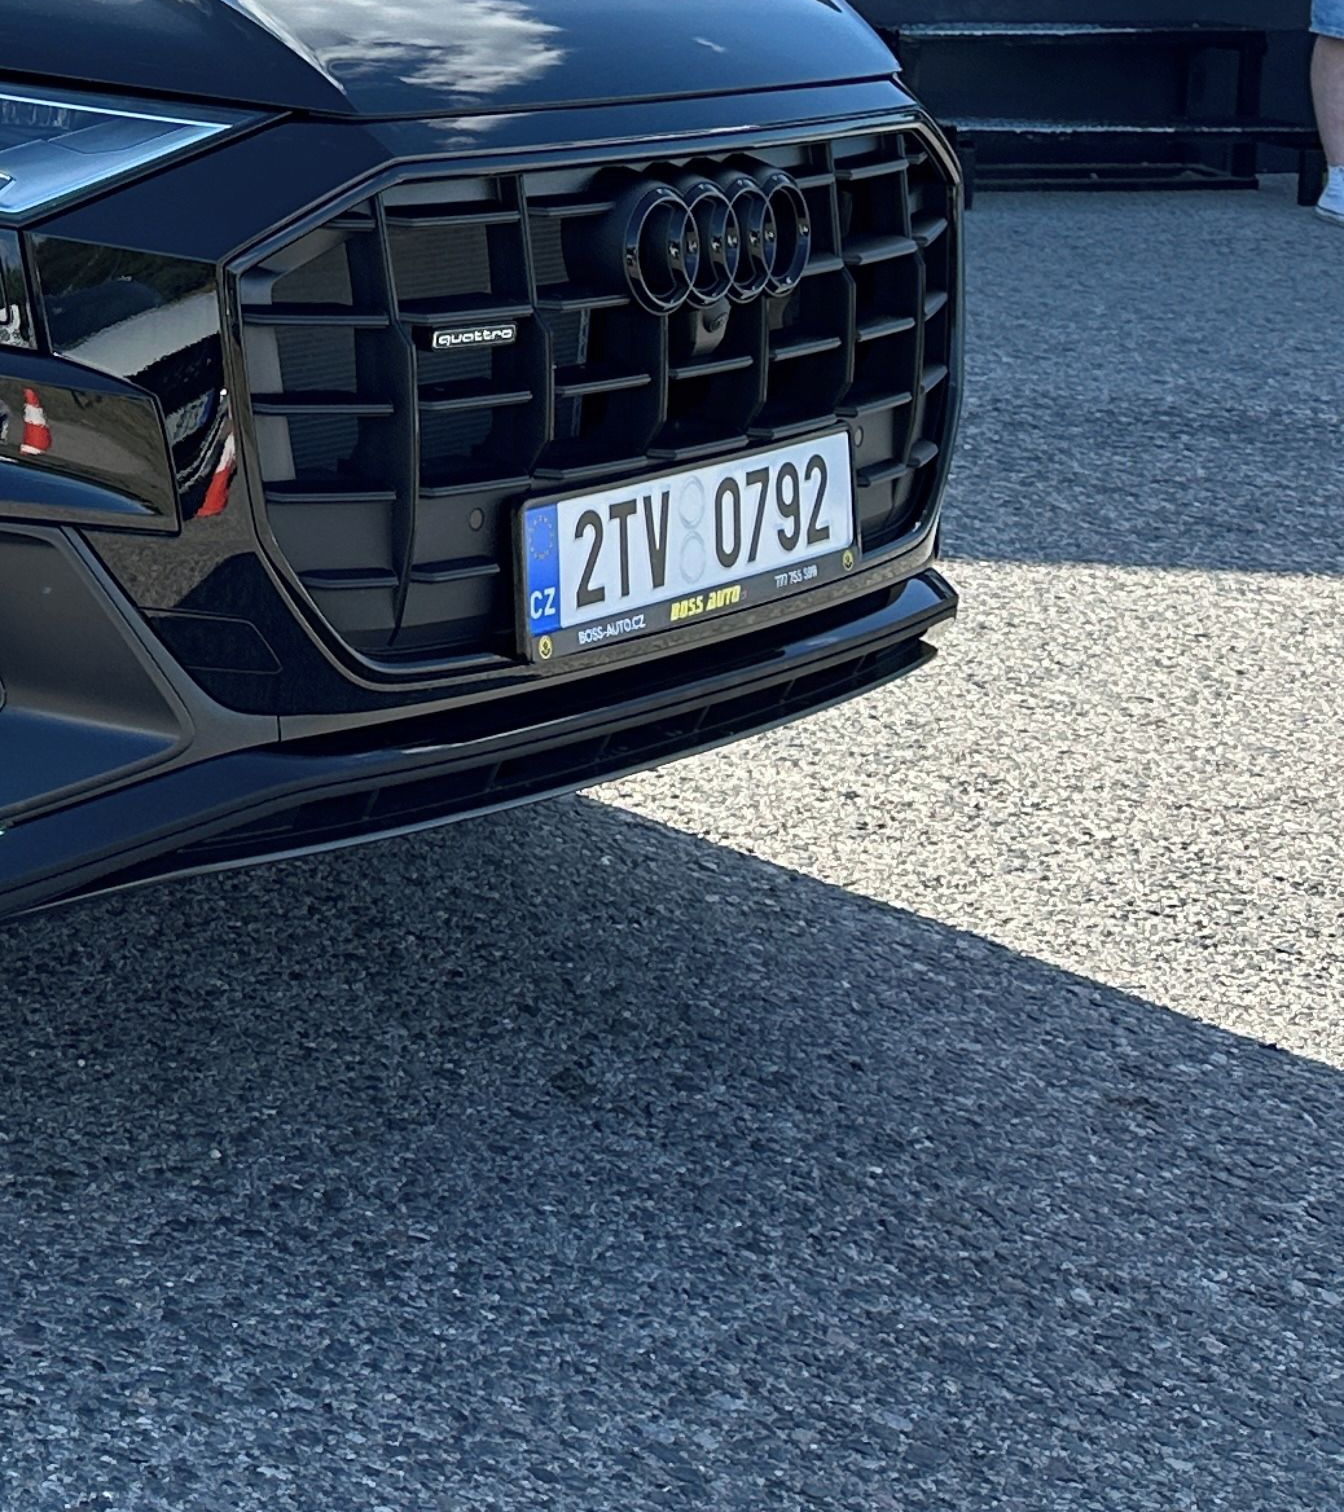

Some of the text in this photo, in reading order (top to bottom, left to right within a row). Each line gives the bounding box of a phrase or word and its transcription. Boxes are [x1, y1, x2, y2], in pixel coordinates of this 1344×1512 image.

[438, 329, 512, 346] quattro
[574, 454, 830, 612] 2TV 0792
[529, 587, 556, 620] CZ
[670, 585, 742, 621] BOSS AUTO
[578, 614, 646, 645] BOSS-AUTO.CZ
